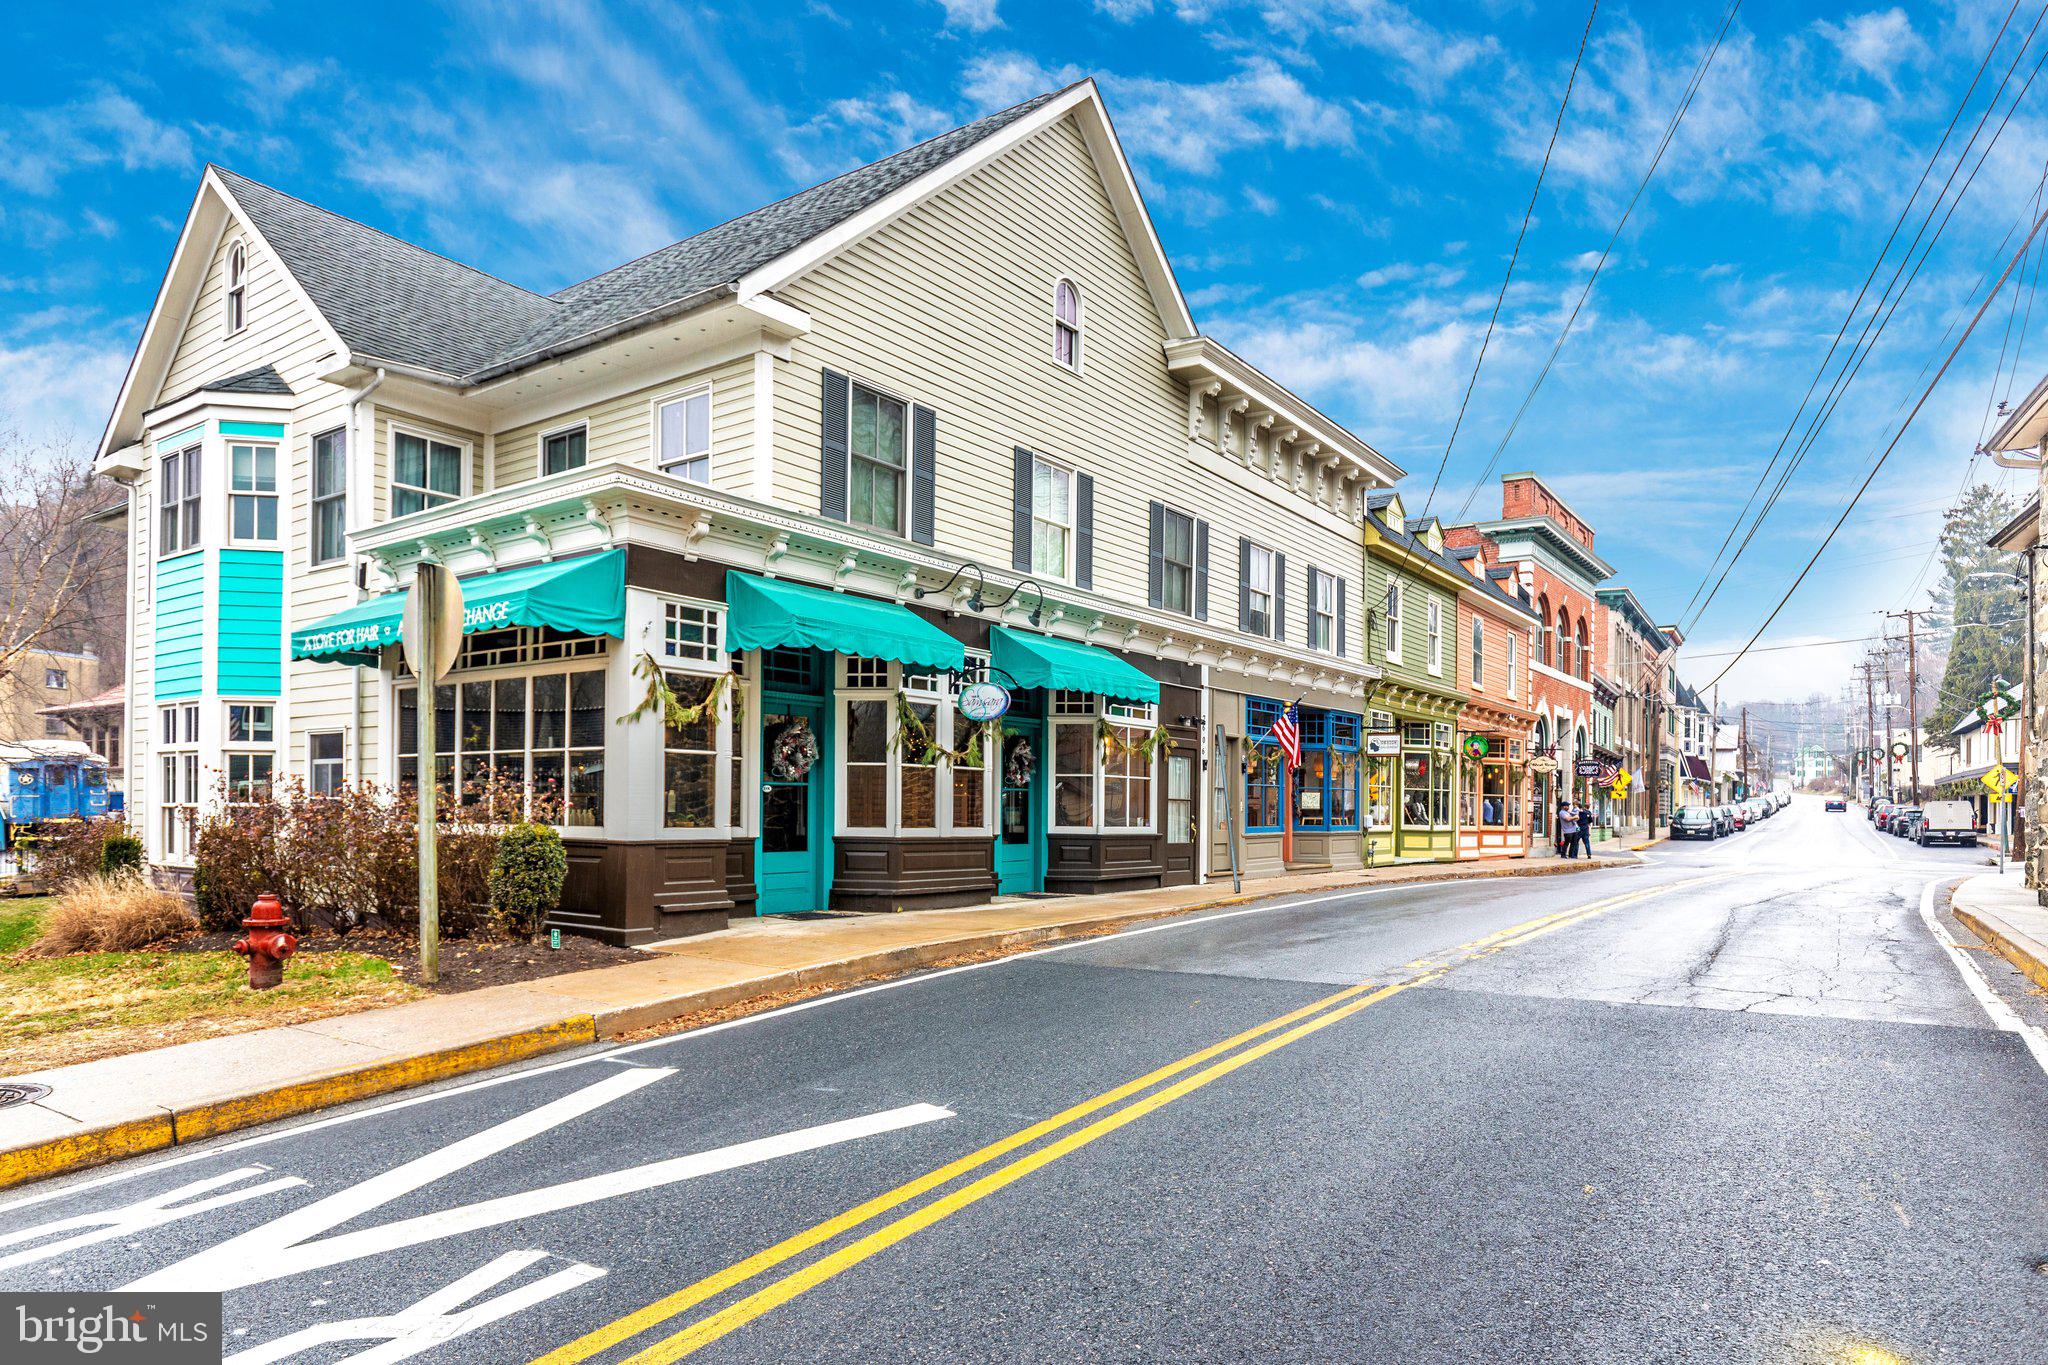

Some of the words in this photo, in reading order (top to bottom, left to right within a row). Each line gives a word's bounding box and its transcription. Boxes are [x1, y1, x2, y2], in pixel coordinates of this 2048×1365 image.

[313, 633, 335, 649] LOVE
[336, 629, 355, 645] FOR
[356, 625, 379, 642] HAIR
